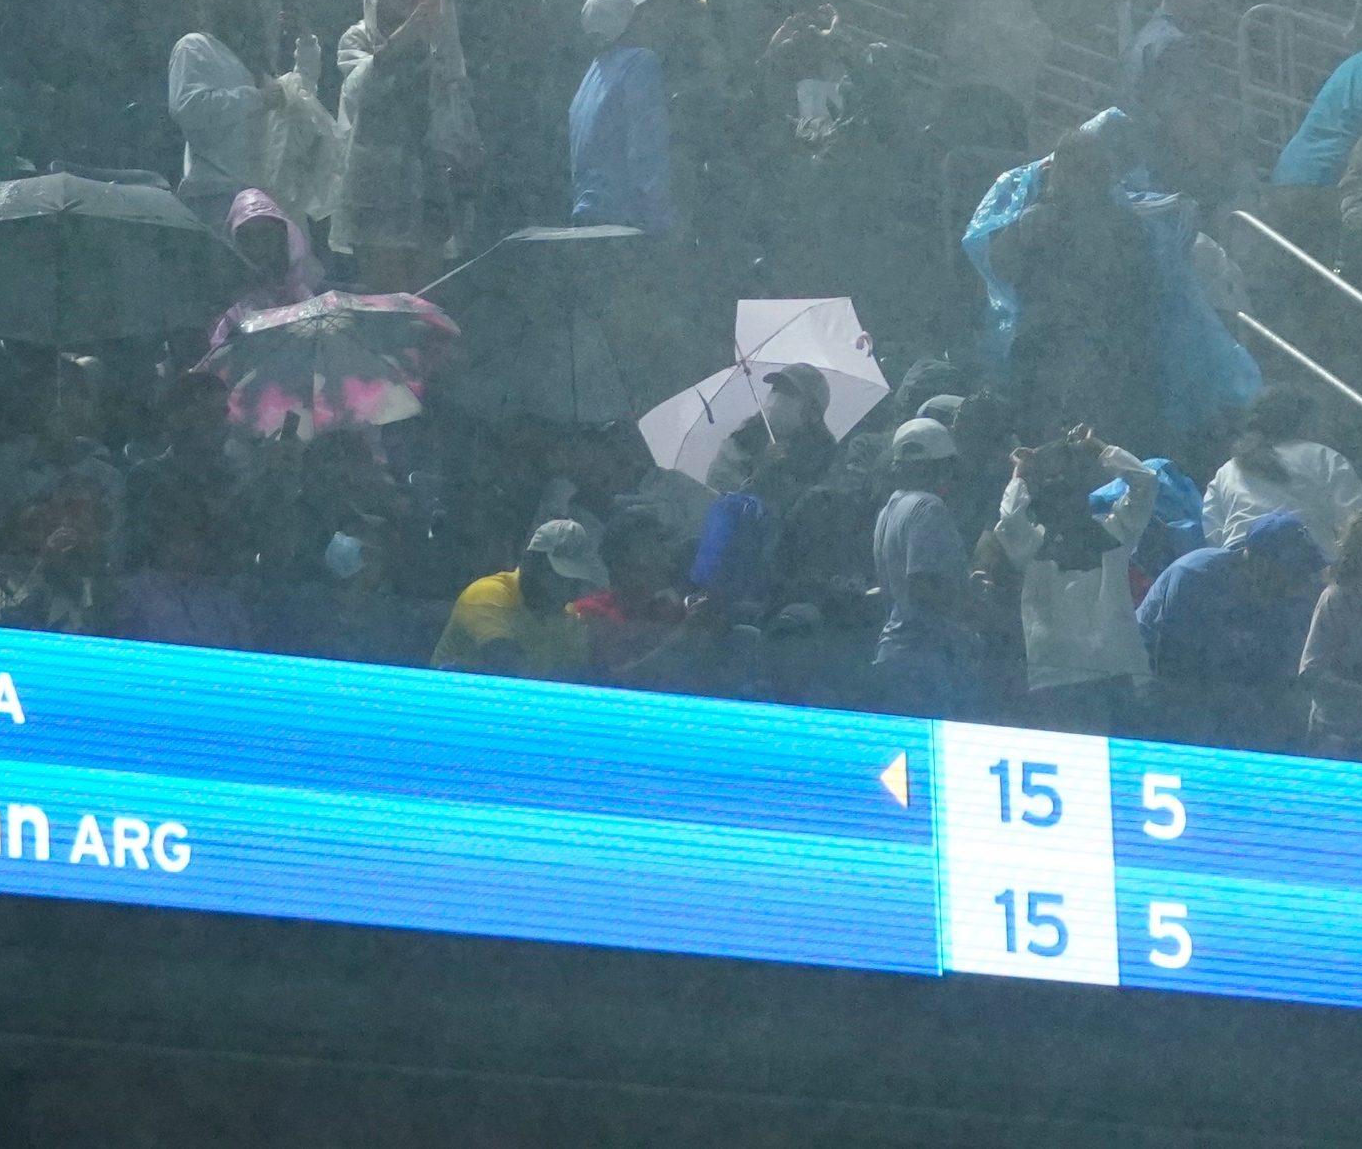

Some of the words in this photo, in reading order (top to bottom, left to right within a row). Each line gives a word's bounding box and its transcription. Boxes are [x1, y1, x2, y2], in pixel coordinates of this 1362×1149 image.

[990, 759, 1063, 828] 15
[1142, 773, 1187, 841] 5
[70, 815, 191, 873] ARG
[995, 889, 1069, 958] 15
[1148, 901, 1193, 969] 5
